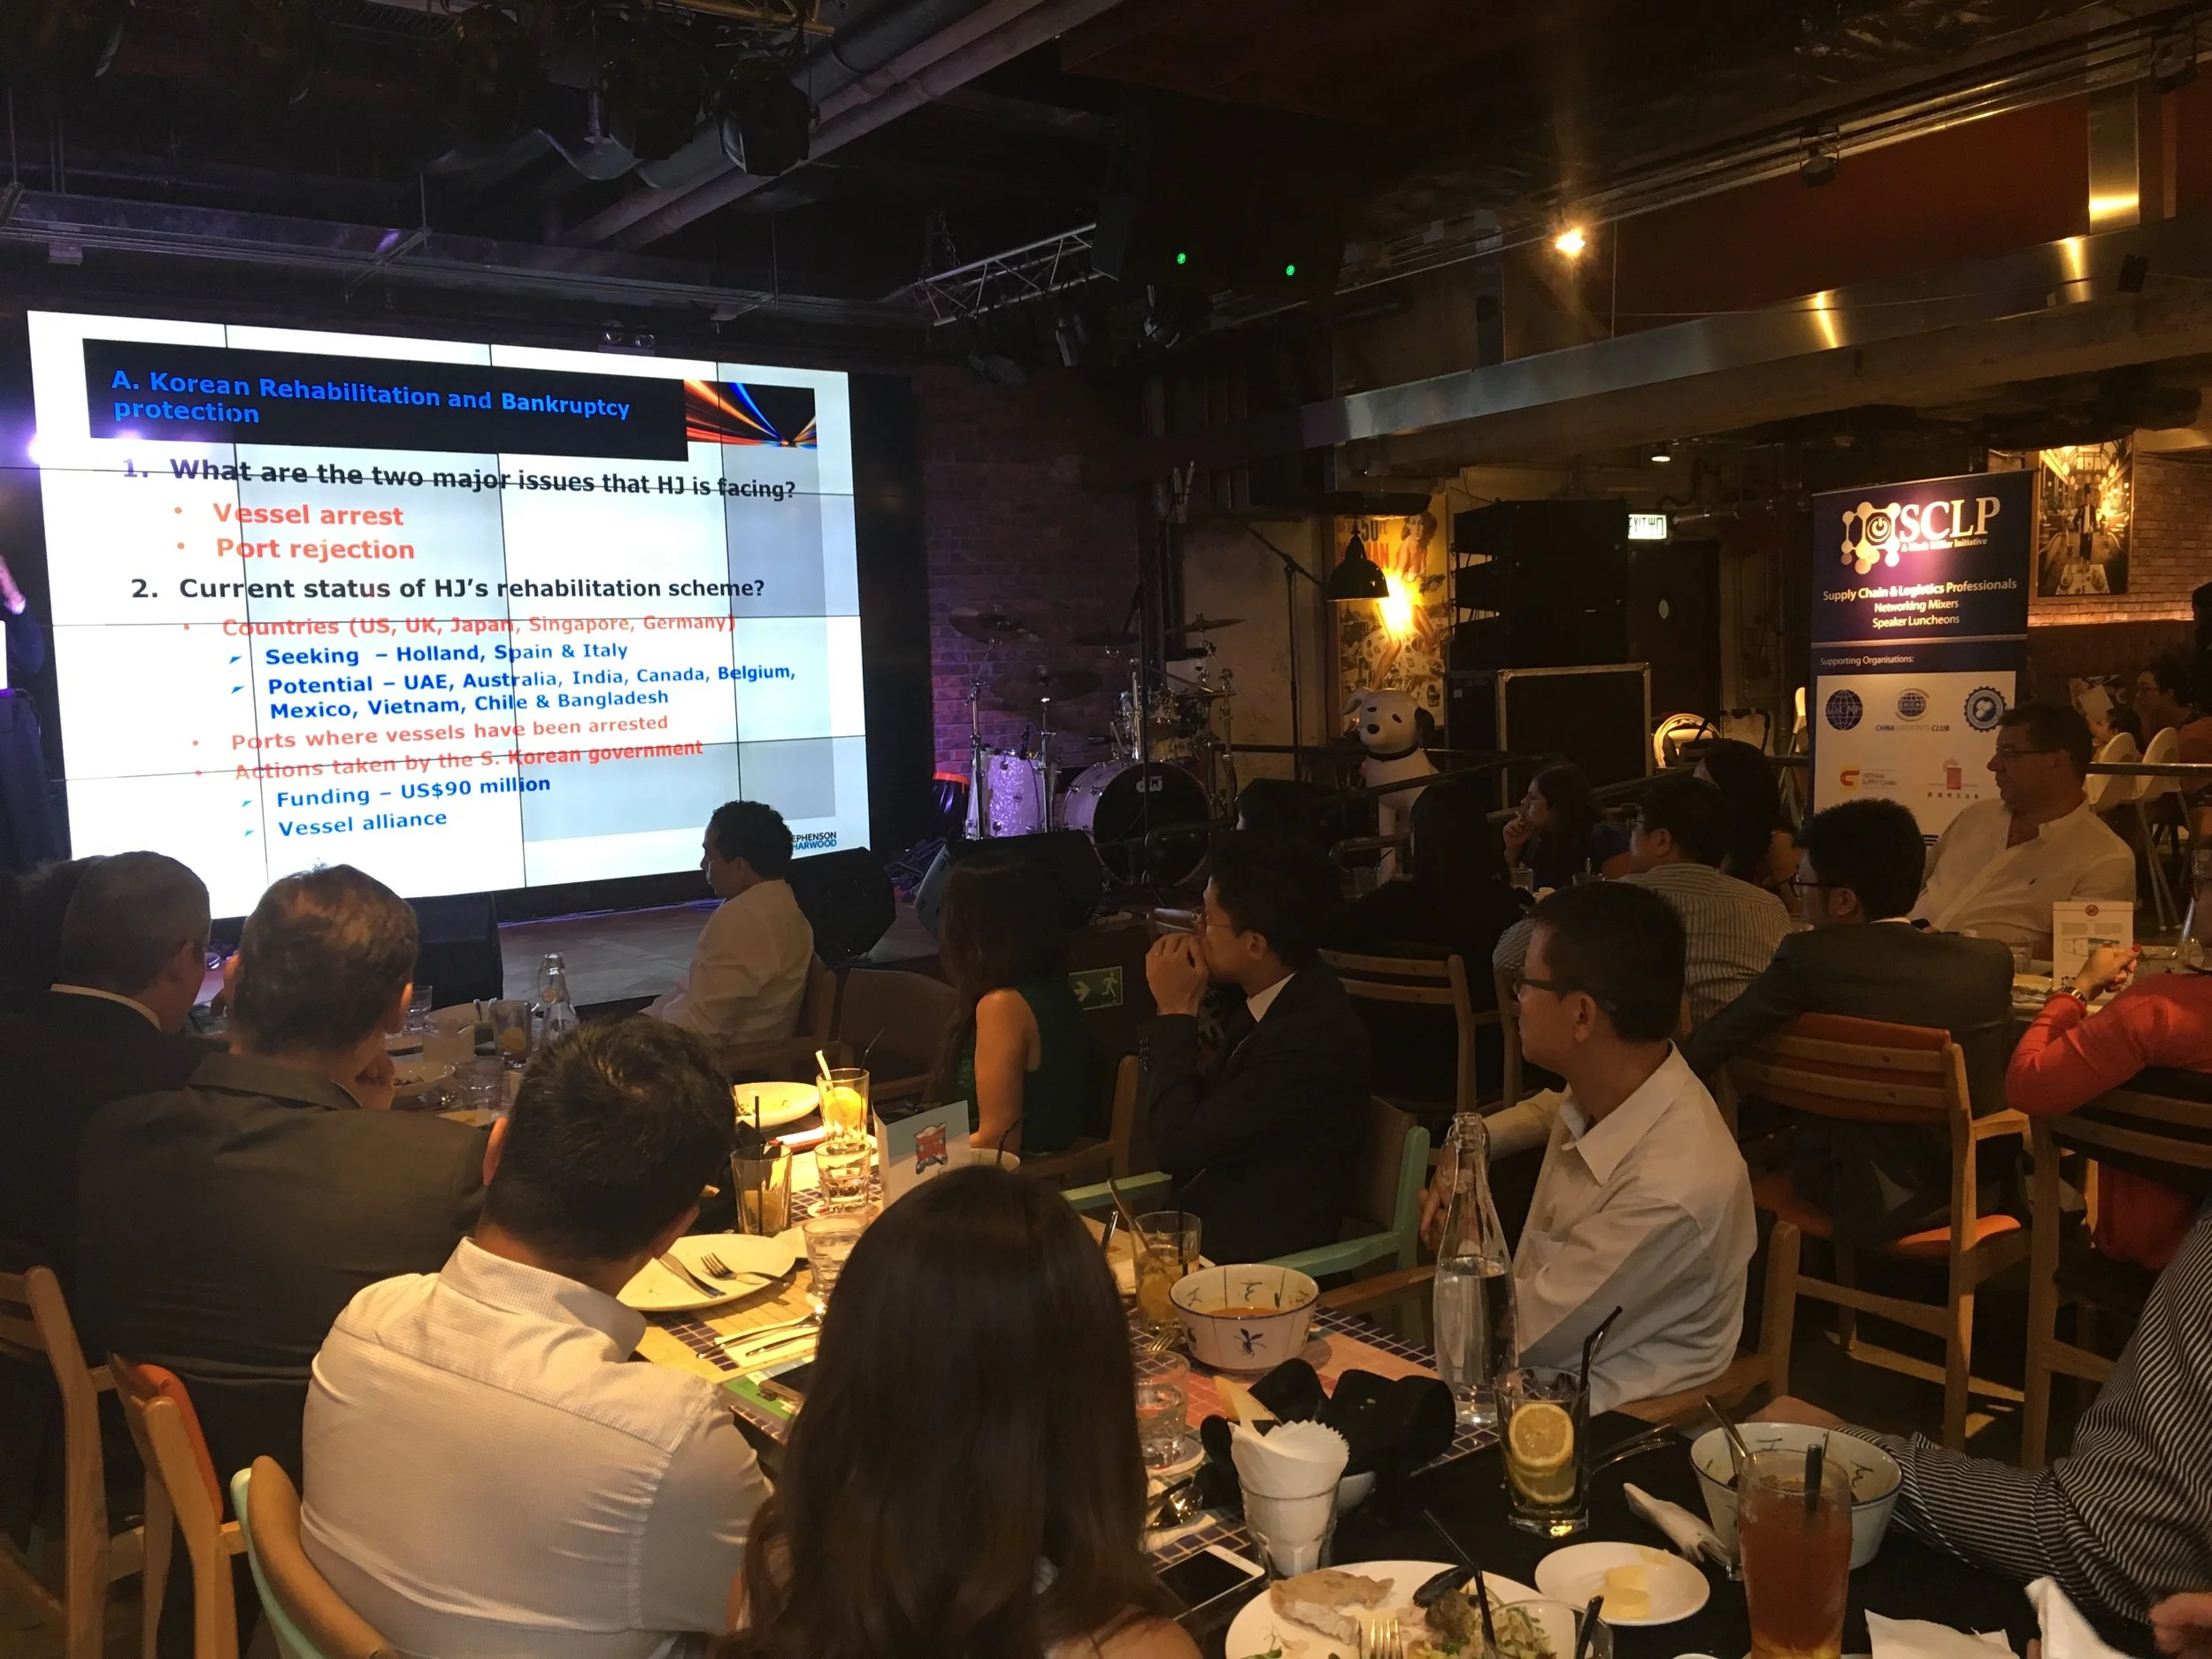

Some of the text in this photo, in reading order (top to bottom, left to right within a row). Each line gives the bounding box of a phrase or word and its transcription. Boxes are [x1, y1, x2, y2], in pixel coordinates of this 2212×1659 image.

[111, 369, 630, 420] A. Korean Rehabilitation and Bankruptcy
[114, 401, 260, 424] protection
[123, 457, 796, 503] 1. What are the two major issues that HJ is facing?
[212, 503, 404, 526] Vessel arrest
[1900, 495, 2001, 543] SCLP
[217, 538, 416, 564] Port rejection
[1955, 538, 1988, 548] Initiative
[132, 579, 158, 598] 2.
[180, 578, 296, 599] Current
[304, 580, 391, 598] status
[400, 578, 426, 598] of
[497, 579, 661, 598] rehabilitation
[668, 579, 765, 597] scheme?
[1823, 578, 2017, 603] Supply Chain & Logistics Professionals
[1874, 598, 1959, 613] Networking Mixers
[222, 614, 736, 638] Countries (US, UK, Japan, Singapore, Germany)
[1872, 615, 1960, 629] Speaker Luncheons
[265, 647, 359, 667] Seeking
[396, 644, 486, 664] Holland,
[494, 643, 553, 664] Spain
[561, 643, 576, 658] &
[583, 642, 628, 660] Italy
[1820, 656, 1915, 667] Supporting Organisations:
[268, 675, 373, 695] Potential
[403, 674, 455, 692] UAE,
[463, 671, 562, 689] Australia,
[572, 669, 629, 687] India,
[636, 666, 710, 683] Canada,
[718, 664, 796, 683] Belgium,
[271, 690, 669, 719] Mexico, Vietnam, Chile & Bangladesh
[232, 715, 669, 750] Ports where vessels have been arrested
[235, 740, 703, 780] Actions taken by the S. Korean government
[277, 786, 371, 808] Funding
[401, 780, 472, 800] US$90
[480, 776, 550, 795] million
[279, 811, 448, 837] Vessel alliance
[792, 832, 837, 842] EPHENSON
